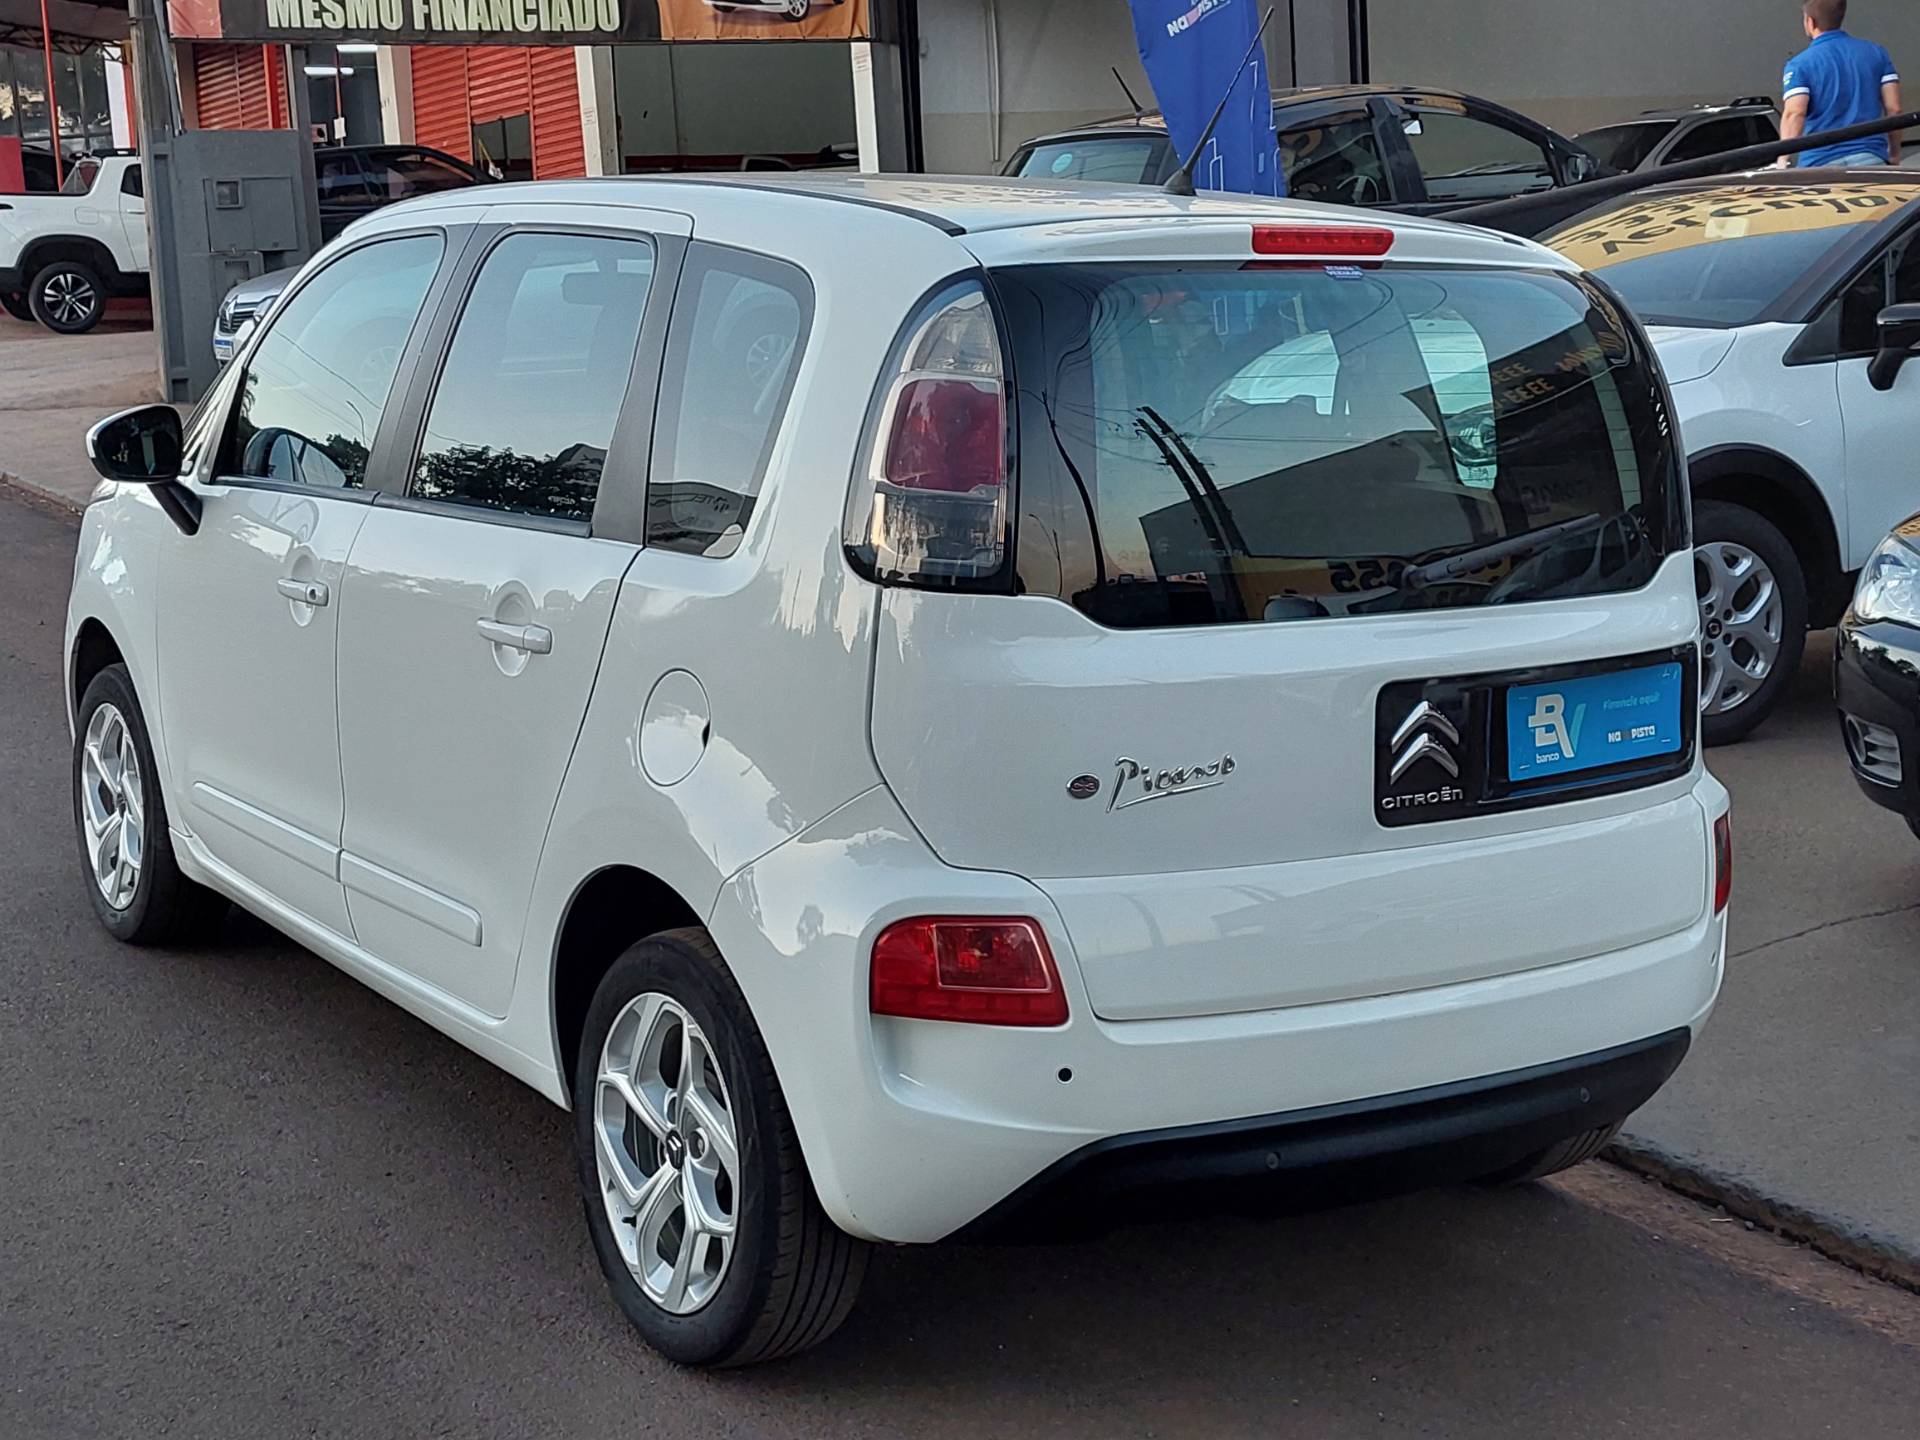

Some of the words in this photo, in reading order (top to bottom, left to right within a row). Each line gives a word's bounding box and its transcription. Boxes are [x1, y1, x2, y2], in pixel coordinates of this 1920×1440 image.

[266, 0, 403, 30] MESMO
[411, 0, 620, 32] FINANCIADO
[1536, 752, 1560, 764] banco
